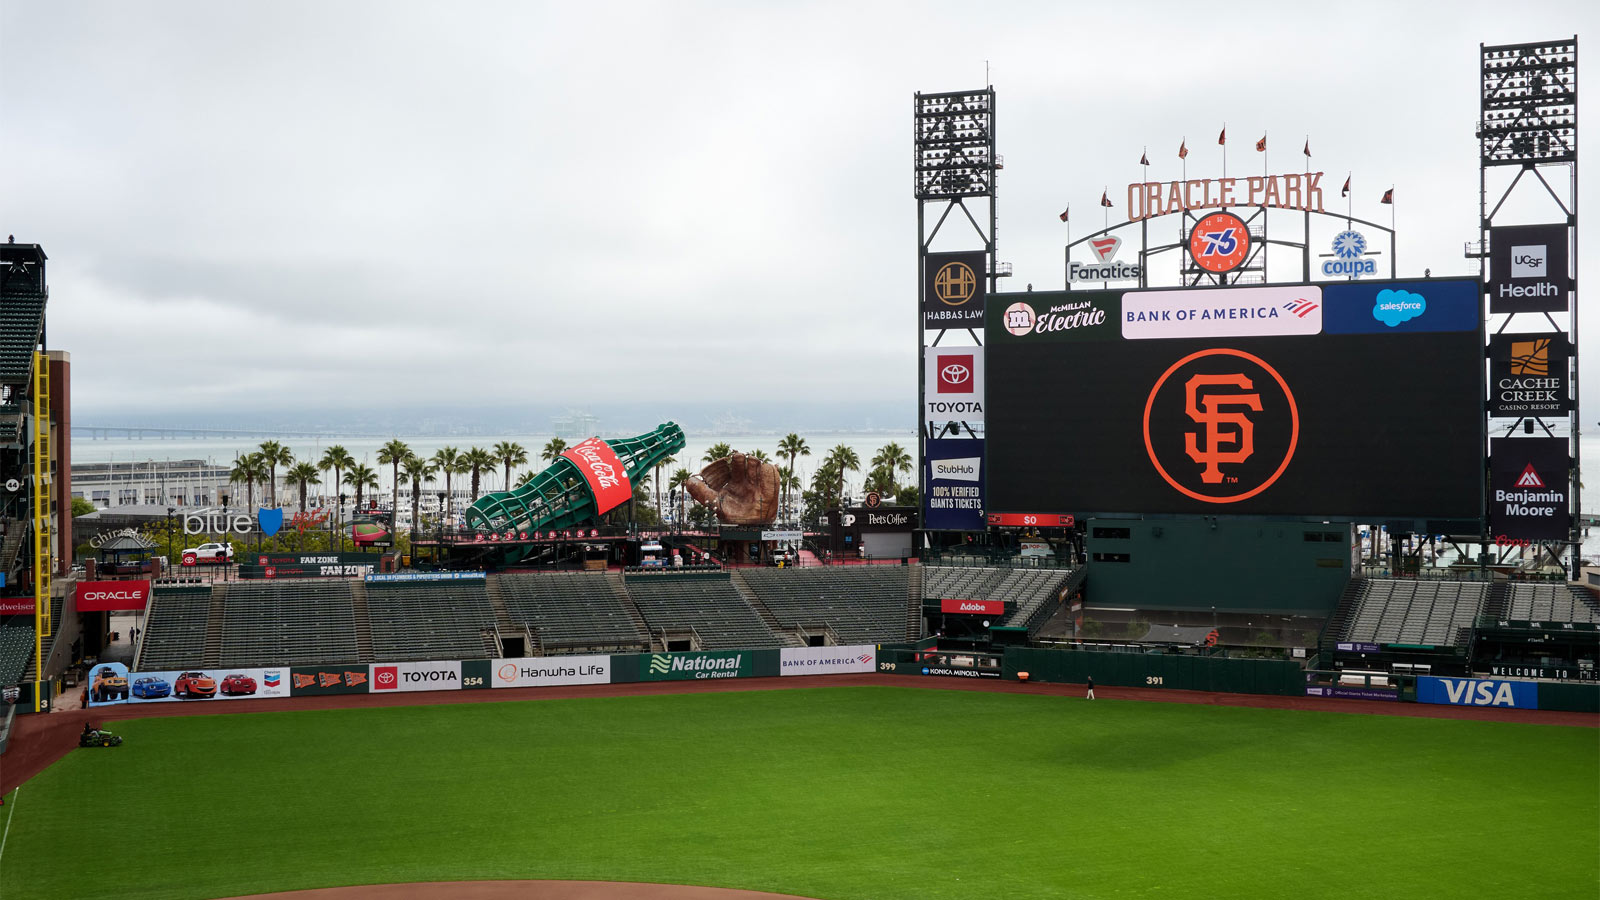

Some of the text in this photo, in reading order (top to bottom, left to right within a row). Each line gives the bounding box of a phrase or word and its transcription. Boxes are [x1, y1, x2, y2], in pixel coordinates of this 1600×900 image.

[1128, 172, 1325, 223] ORACLE PARK
[1202, 228, 1238, 256] 76
[1514, 255, 1543, 268] UCSF
[1070, 264, 1140, 280] Fanatics
[1324, 261, 1374, 277] coupa
[1499, 282, 1558, 298] Health
[1050, 301, 1091, 313] McMILLAN
[1380, 301, 1421, 312] salesforce
[927, 310, 984, 320] HABBAS LAW
[1126, 307, 1278, 322] BANK OF AMERICA
[1035, 307, 1106, 334] Electric
[1499, 378, 1560, 389] CACHE
[1501, 391, 1558, 402] CREEK
[928, 402, 982, 413] TOYOTA
[937, 464, 974, 474] StubHub
[933, 486, 980, 497] 100% VERIFIED
[1496, 490, 1564, 505] Benjamin
[930, 498, 981, 509] GIANTS TICKETS
[1506, 504, 1553, 516] Moore
[184, 509, 253, 534] blue
[868, 513, 907, 525] Peet's Coffee
[1024, 516, 1036, 524] $0
[1495, 534, 1530, 547] Coors
[320, 566, 342, 576] FAN
[84, 590, 142, 600] ORACLE
[0, 602, 35, 610] dweiser
[960, 603, 985, 611] Adobe
[672, 654, 741, 671] National
[880, 662, 896, 670] 399
[403, 670, 457, 682] TOYOTA
[521, 664, 604, 677] Hanwha Life
[1493, 667, 1544, 677] WELCOME
[1556, 669, 1568, 678] TO
[464, 676, 483, 685] 354
[1146, 676, 1163, 685] 391
[1439, 679, 1515, 706] VISA
[41, 700, 48, 708] 3
